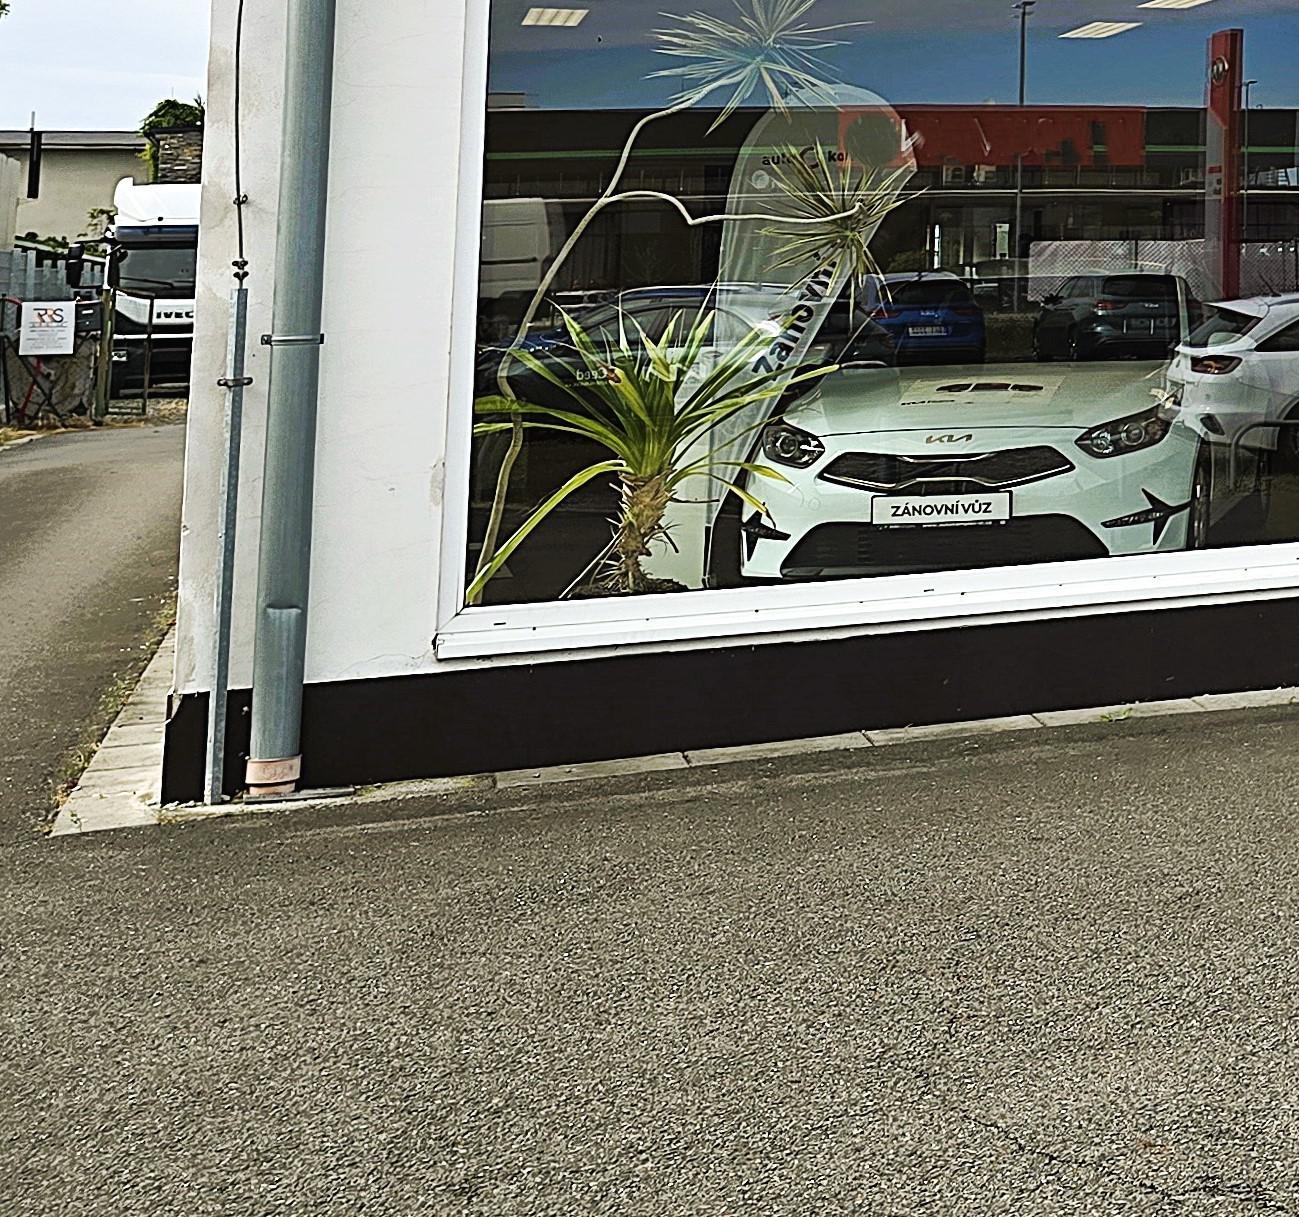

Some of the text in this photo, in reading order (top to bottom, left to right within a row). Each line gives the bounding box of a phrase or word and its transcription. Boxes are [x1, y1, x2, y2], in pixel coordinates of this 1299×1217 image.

[156, 311, 194, 319] IVEC
[890, 499, 993, 518] ZÁNOVNÍ VŮZ
